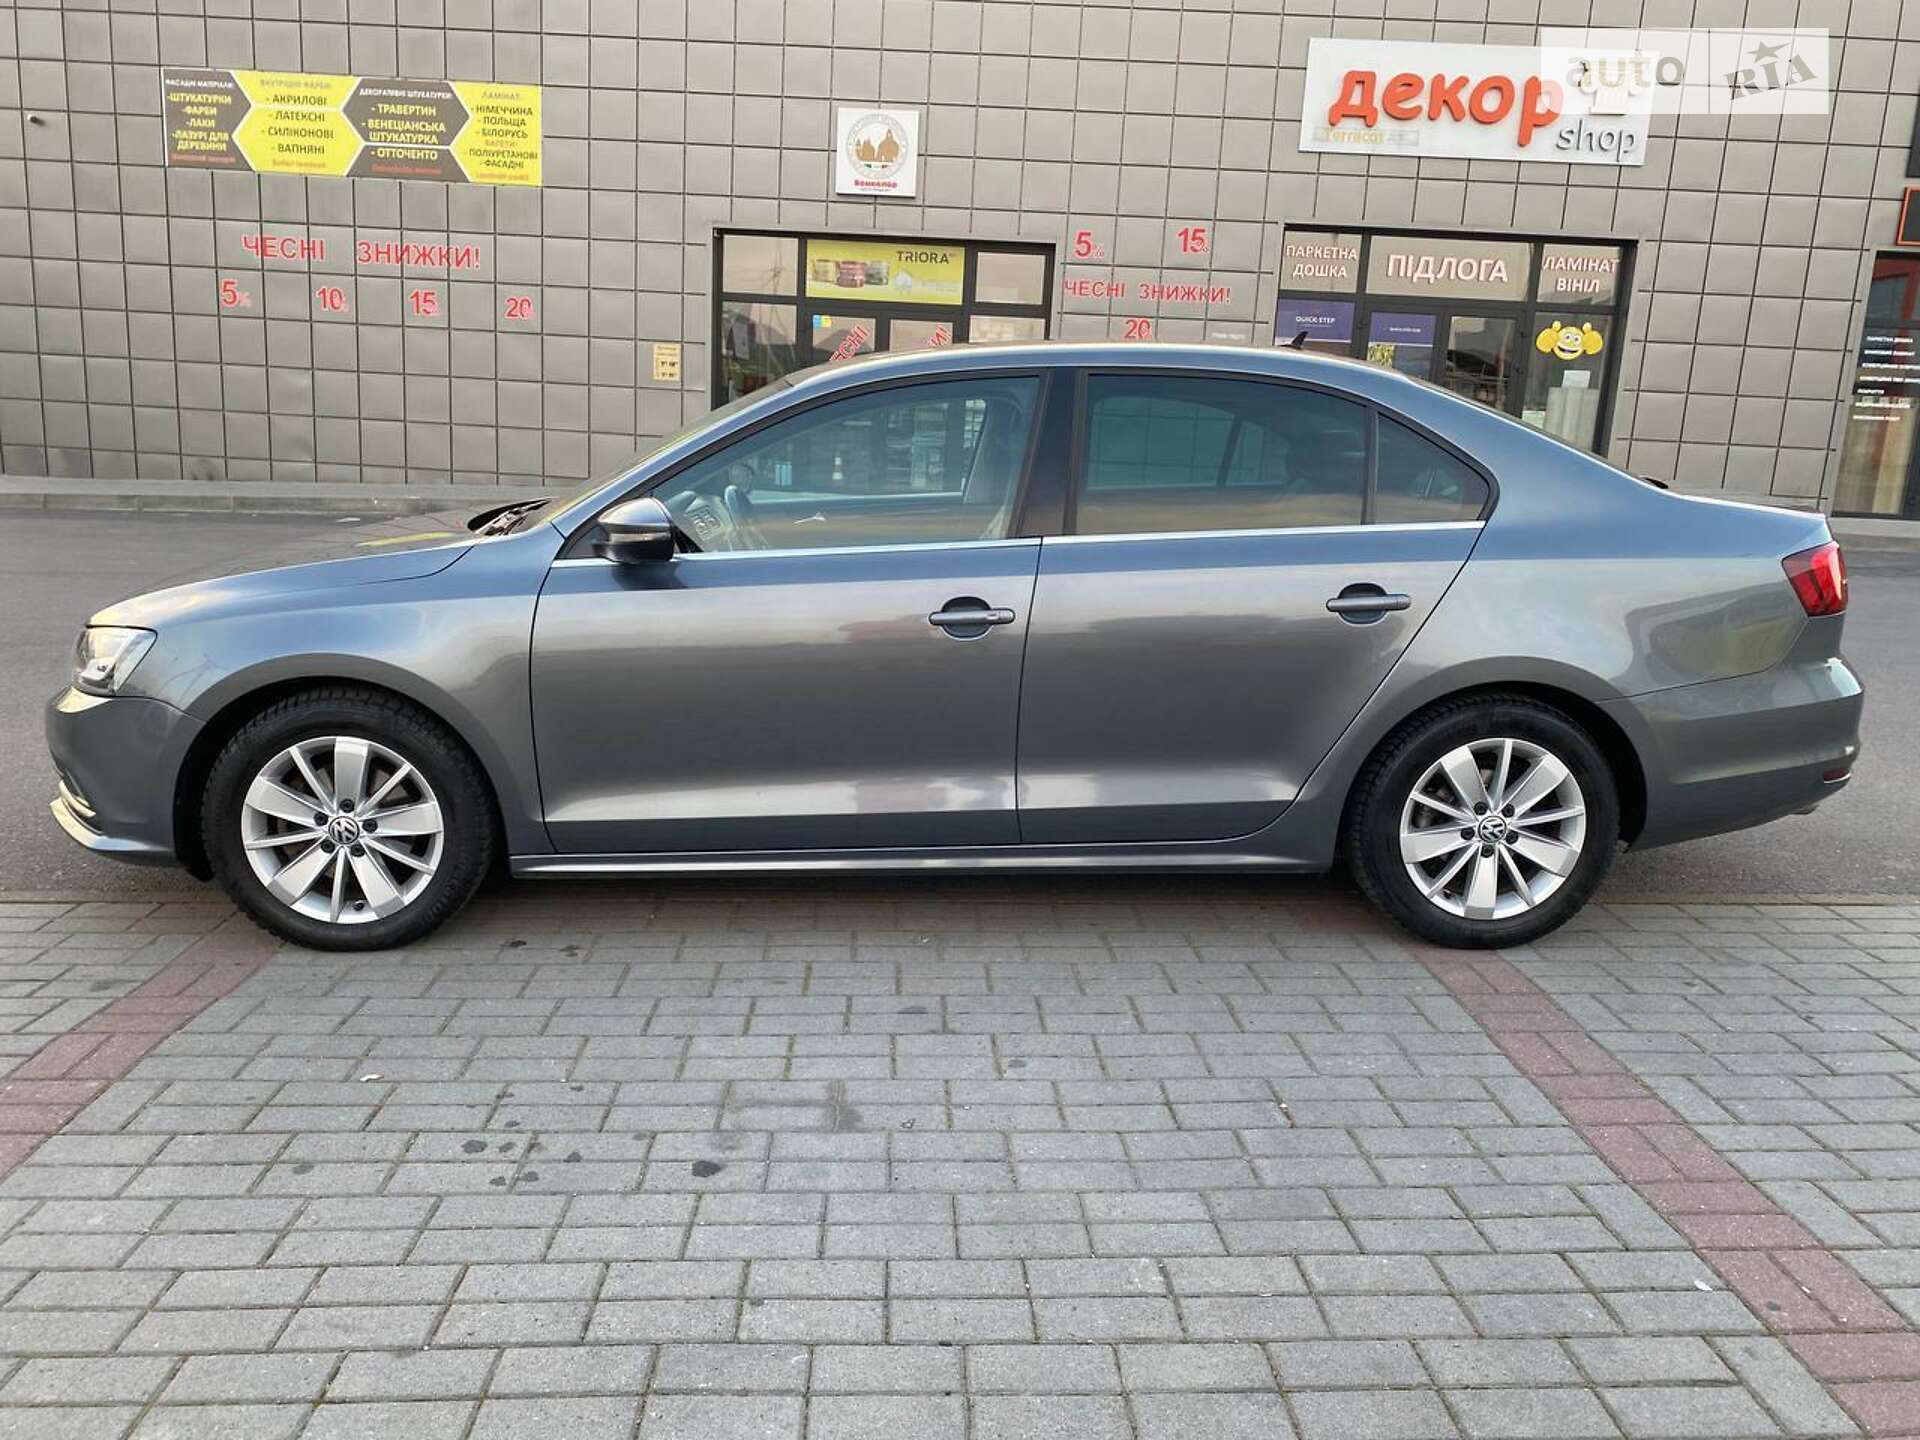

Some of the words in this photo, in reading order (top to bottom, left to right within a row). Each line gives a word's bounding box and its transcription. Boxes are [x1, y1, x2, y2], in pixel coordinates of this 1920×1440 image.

[1327, 68, 1564, 147] декор
[1554, 119, 1636, 163] shop
[241, 235, 326, 261] ЧЕСНІ
[356, 240, 481, 270] ЗНИЖКИ!
[895, 249, 950, 265] TRIORA
[1285, 243, 1359, 262] ПАРКЕТНА
[1292, 262, 1348, 279] ДОШКА
[1387, 253, 1510, 284] ПІДЛОГА
[1542, 255, 1621, 274] ЛАМІНАТ
[1064, 279, 1126, 299] ЧЕСНІ
[1138, 282, 1232, 304] ЗНИЖКИ!
[1555, 276, 1601, 294] ВІНІЛ
